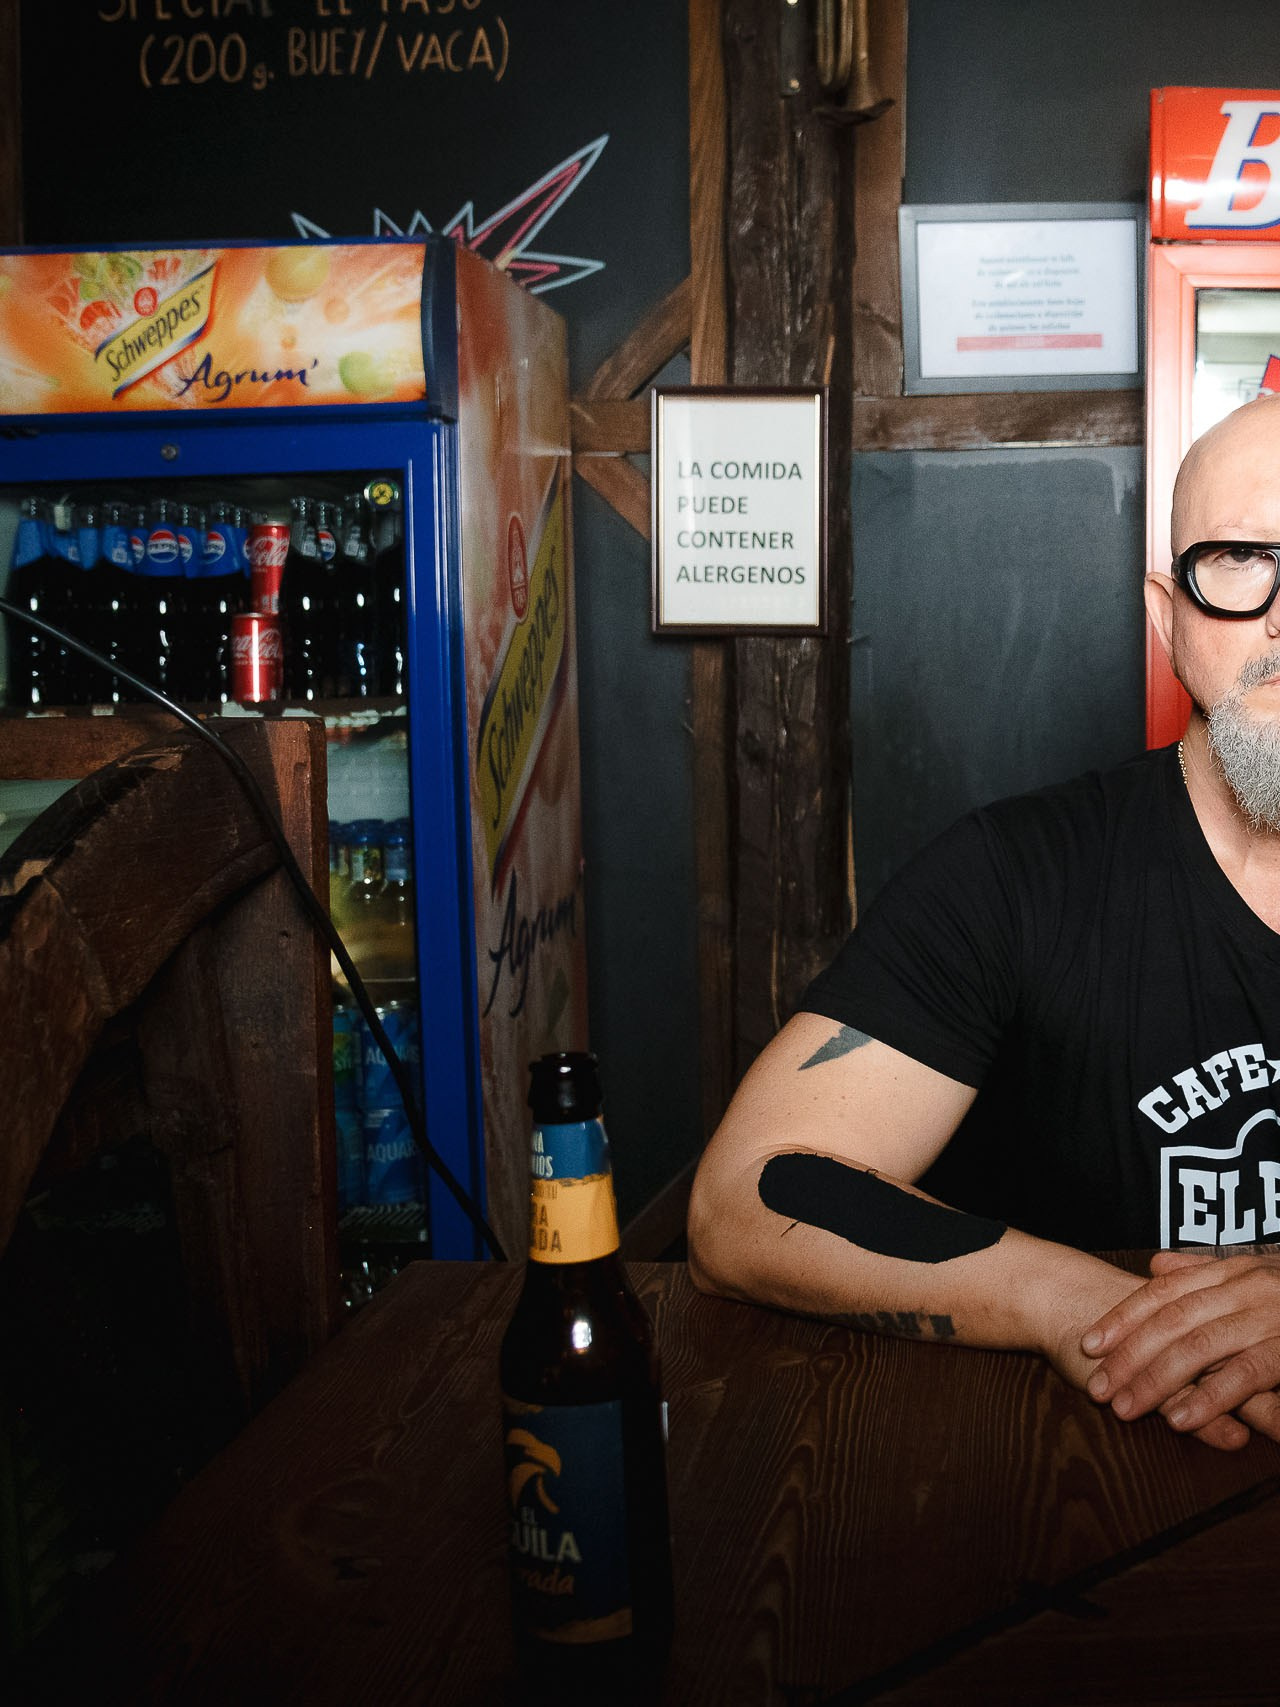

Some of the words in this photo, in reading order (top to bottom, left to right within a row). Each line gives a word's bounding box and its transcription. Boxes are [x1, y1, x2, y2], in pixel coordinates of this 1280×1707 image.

[106, 289, 202, 382] Schweppes
[678, 461, 703, 479] LA
[710, 461, 803, 480] COMIDA
[677, 496, 749, 515] PUEDE
[676, 531, 795, 550] CONTENER
[676, 566, 806, 585] ALERGENOS
[489, 546, 560, 831] Schweppes
[1138, 1043, 1269, 1134] CAFE
